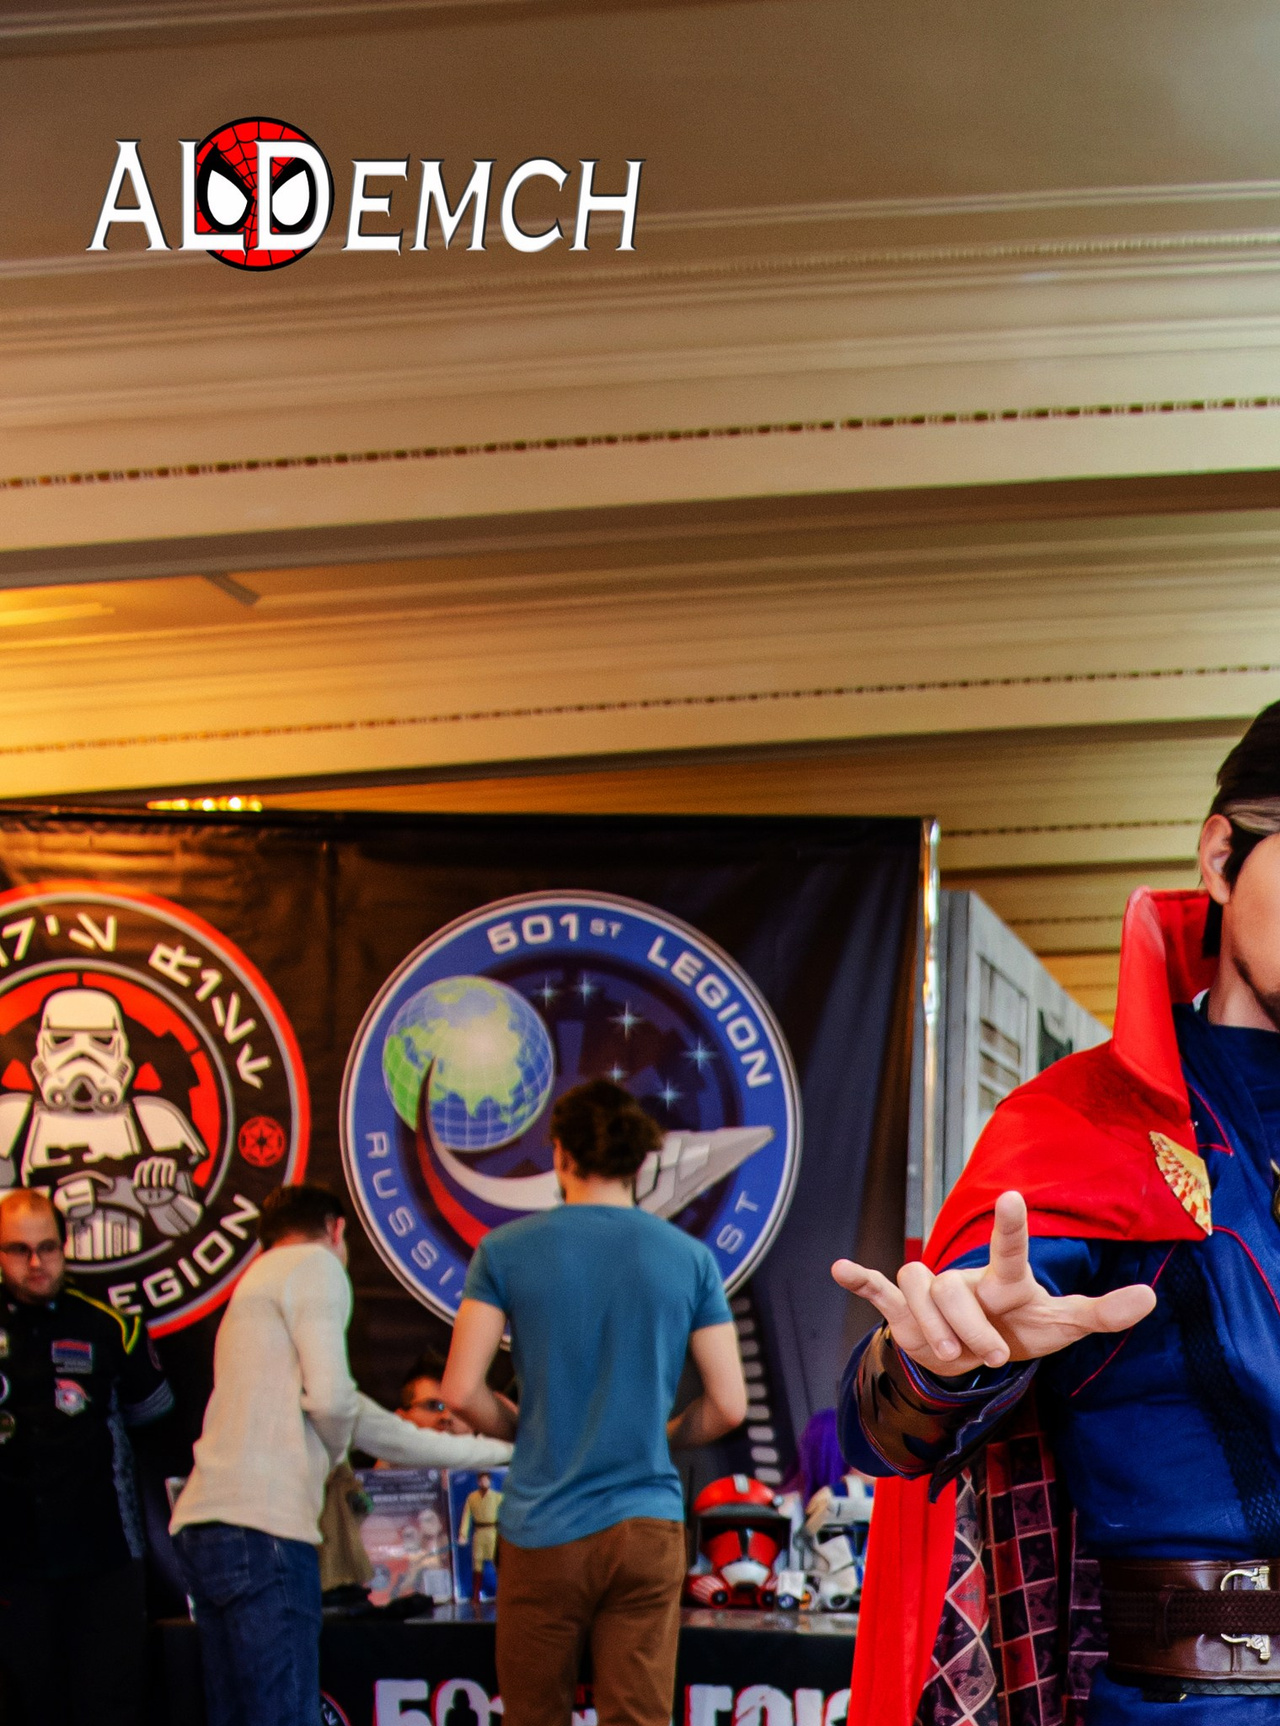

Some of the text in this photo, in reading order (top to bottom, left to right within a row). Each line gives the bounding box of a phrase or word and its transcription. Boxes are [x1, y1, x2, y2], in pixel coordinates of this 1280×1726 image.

[646, 935, 774, 1089] LEGION
[108, 1193, 262, 1316] EGION
[364, 1131, 459, 1295] RUSSI
